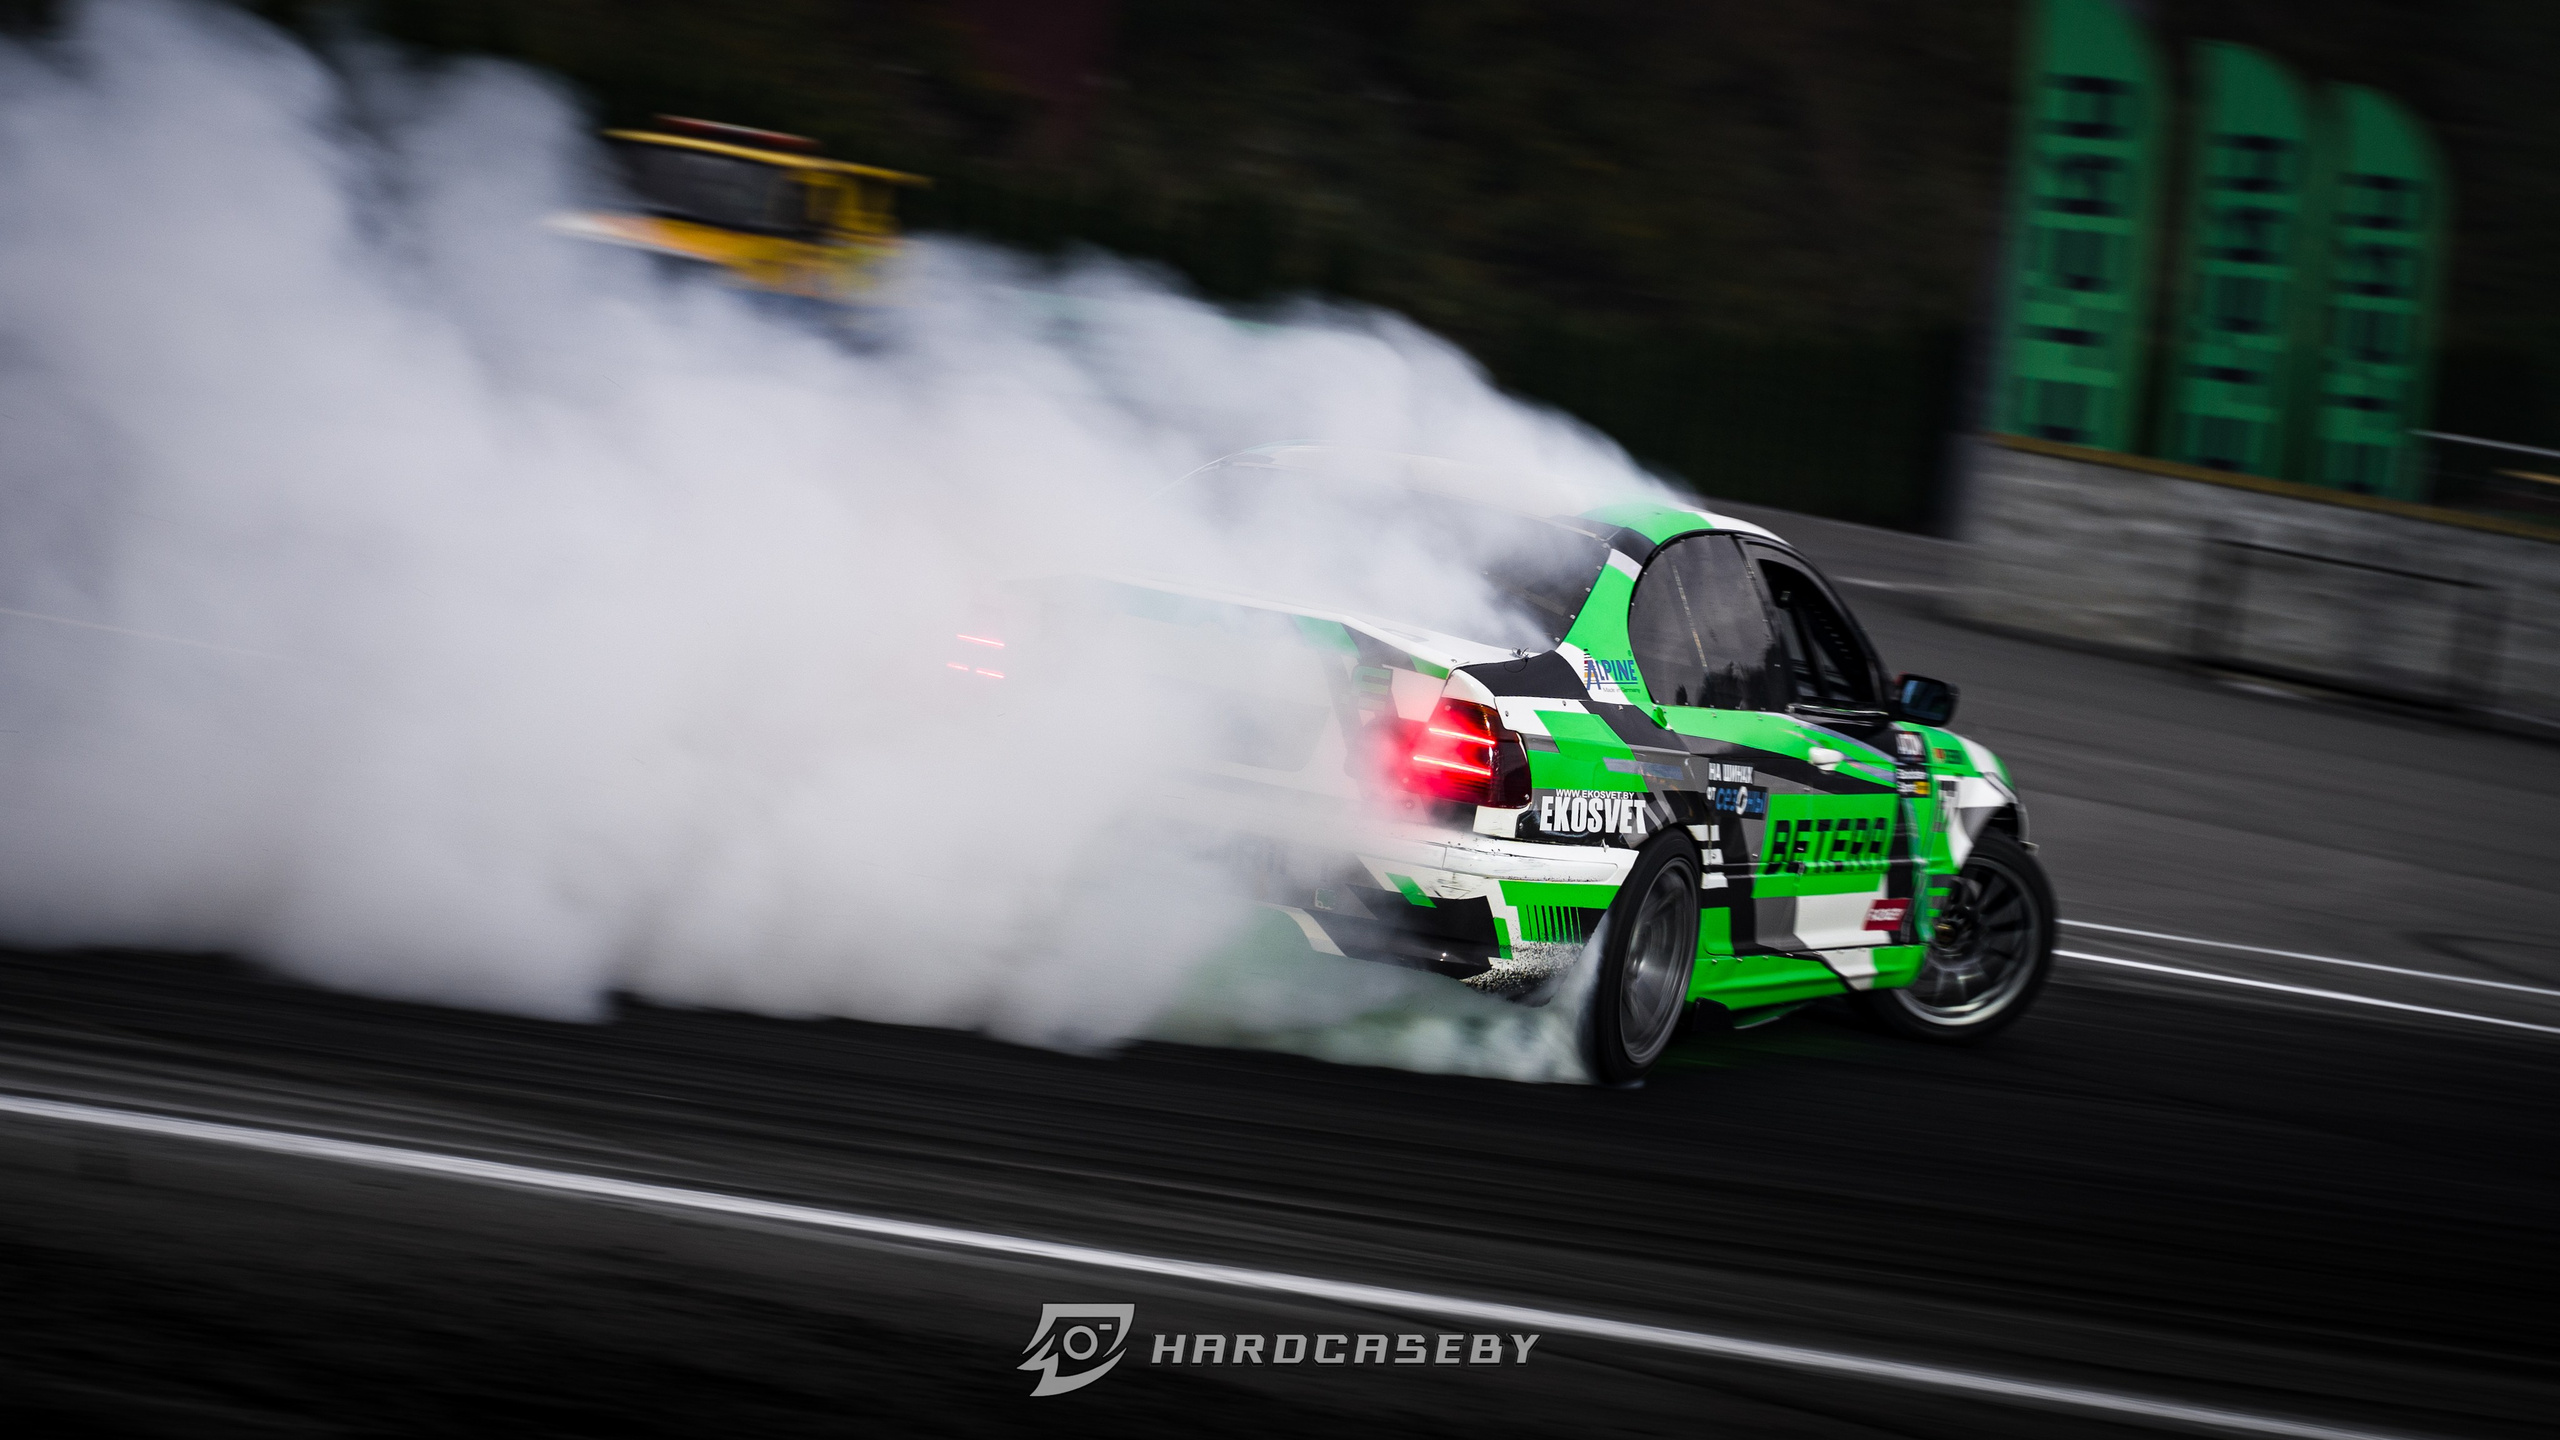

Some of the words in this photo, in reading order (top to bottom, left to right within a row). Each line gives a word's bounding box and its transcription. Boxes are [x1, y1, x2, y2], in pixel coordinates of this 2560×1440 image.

[1586, 659, 1638, 691] ALPINE
[1708, 762, 1722, 781] НА
[1555, 788, 1636, 801] WWW.EKOSVET.BY
[1539, 796, 1648, 835] EKOSVET
[1765, 818, 1888, 875] BETERA
